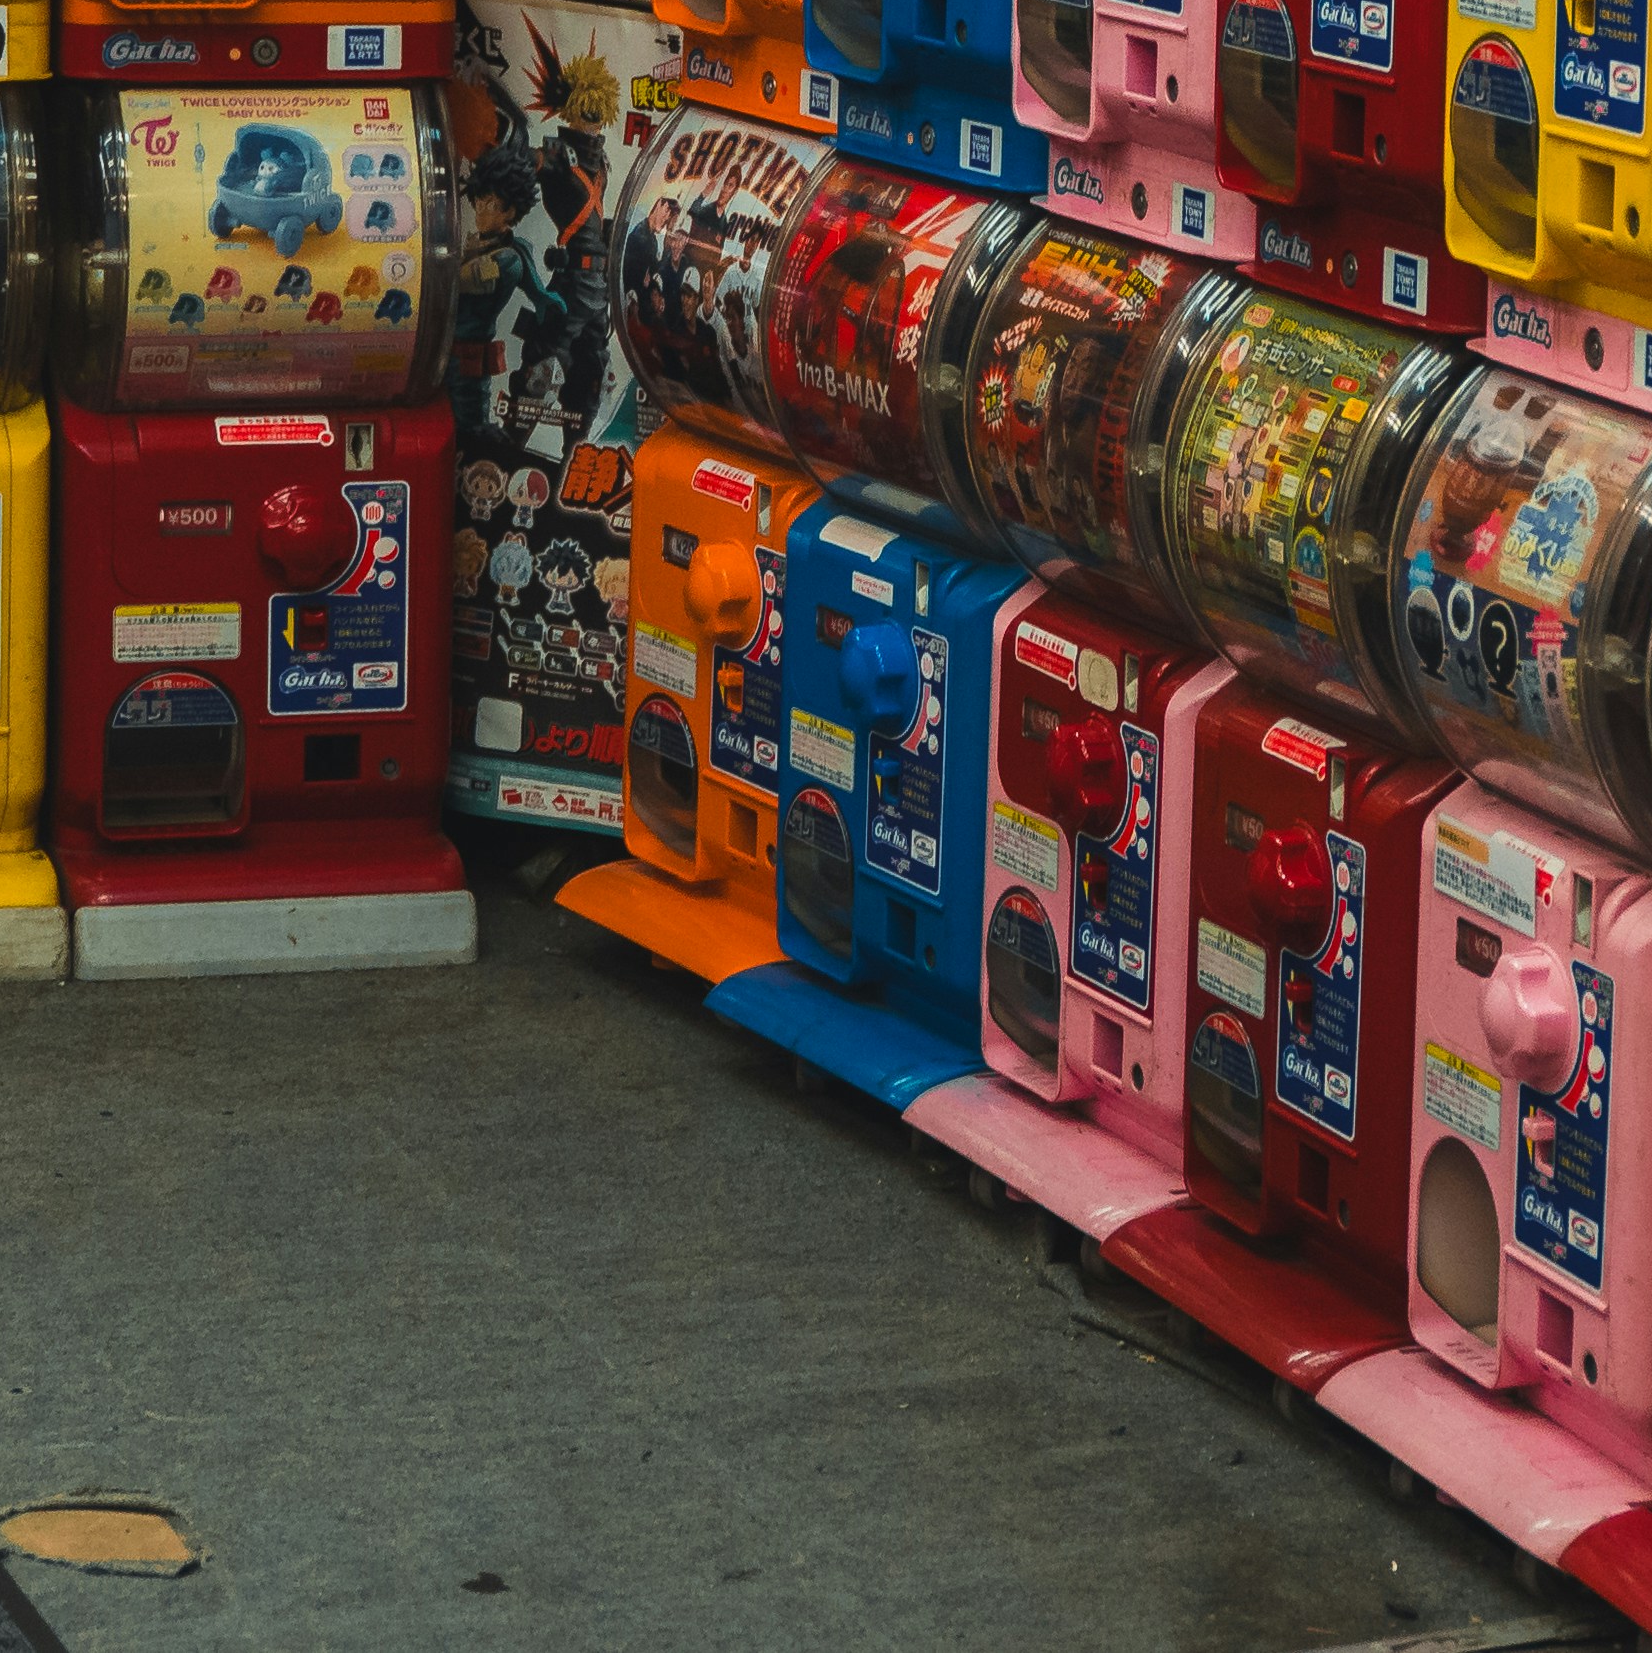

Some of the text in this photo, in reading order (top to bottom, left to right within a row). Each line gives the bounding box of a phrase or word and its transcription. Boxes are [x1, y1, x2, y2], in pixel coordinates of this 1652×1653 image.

[181, 97, 222, 107] TWICE
[147, 159, 176, 167] TWICE
[664, 130, 810, 219] SHOTIME
[824, 364, 892, 418] B-MAX
[168, 507, 218, 526] ¥500
[278, 667, 349, 694] Gacha.
